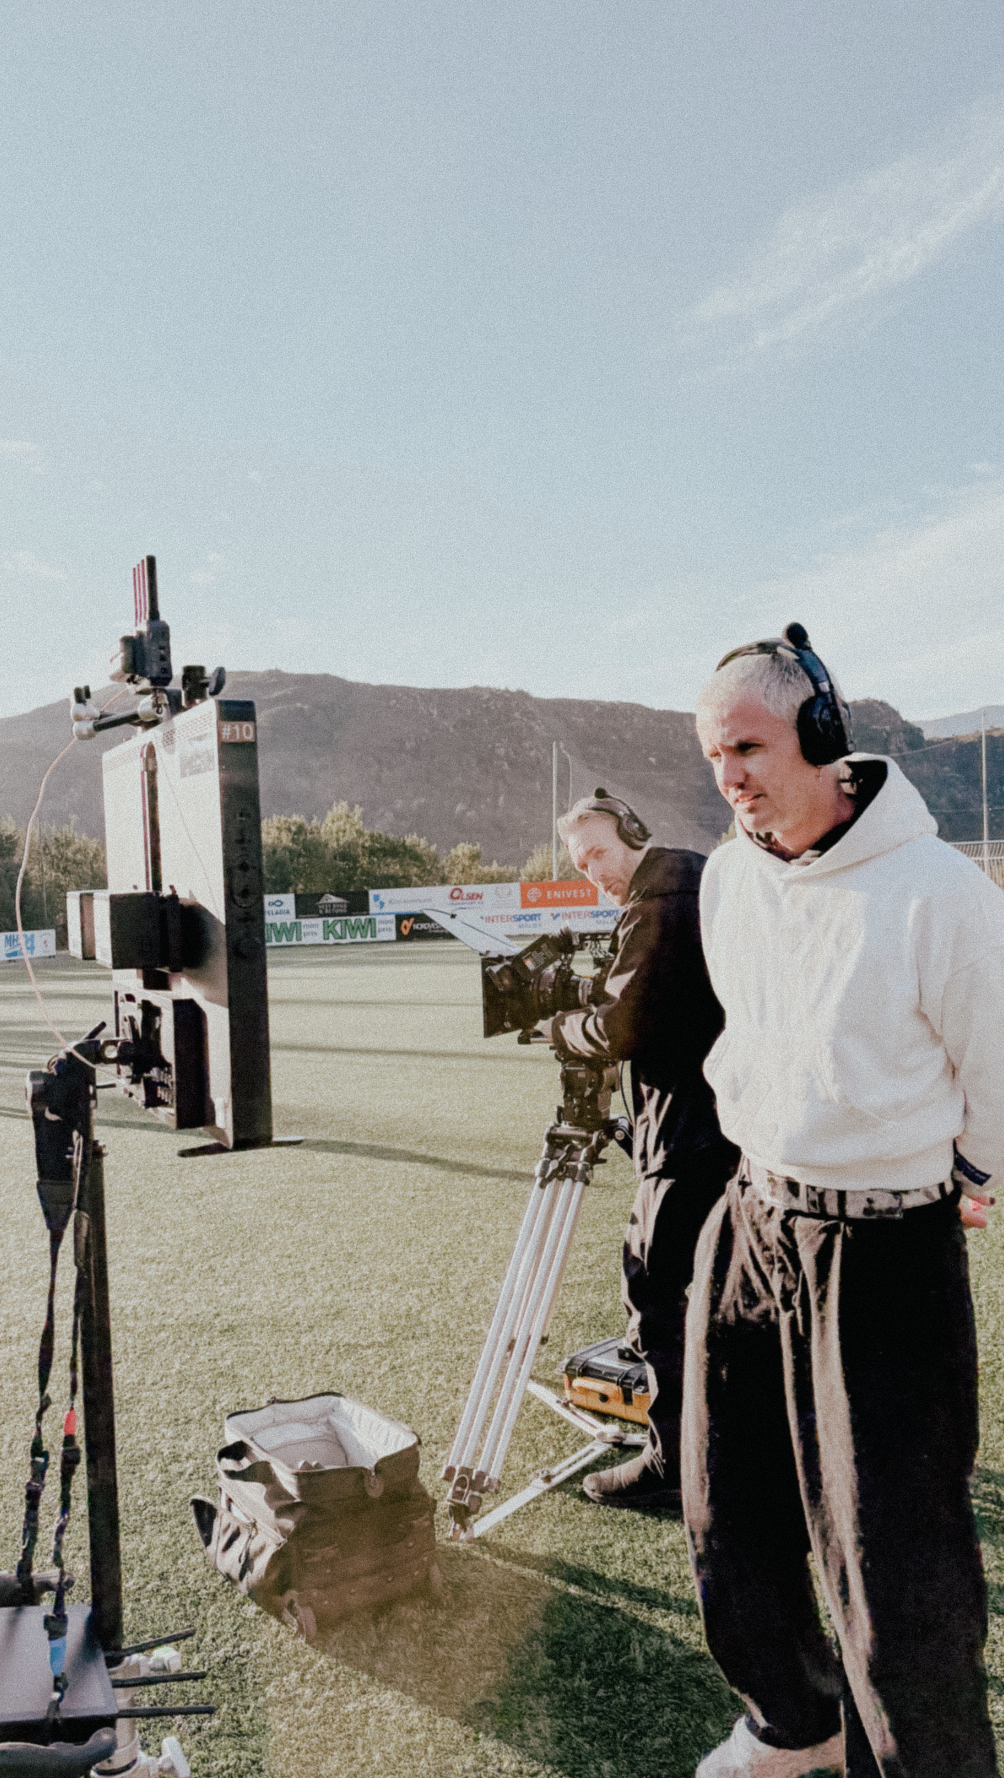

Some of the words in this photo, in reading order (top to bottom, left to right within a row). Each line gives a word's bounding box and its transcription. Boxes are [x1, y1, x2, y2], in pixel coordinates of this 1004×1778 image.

[222, 724, 254, 740] #10
[449, 887, 484, 901] OLSEN
[547, 889, 591, 899] ENIVEST
[484, 913, 542, 924] INTERSPORT
[561, 909, 620, 921] INTERSPORT
[265, 921, 302, 943] IWI
[323, 917, 377, 941] KIWI
